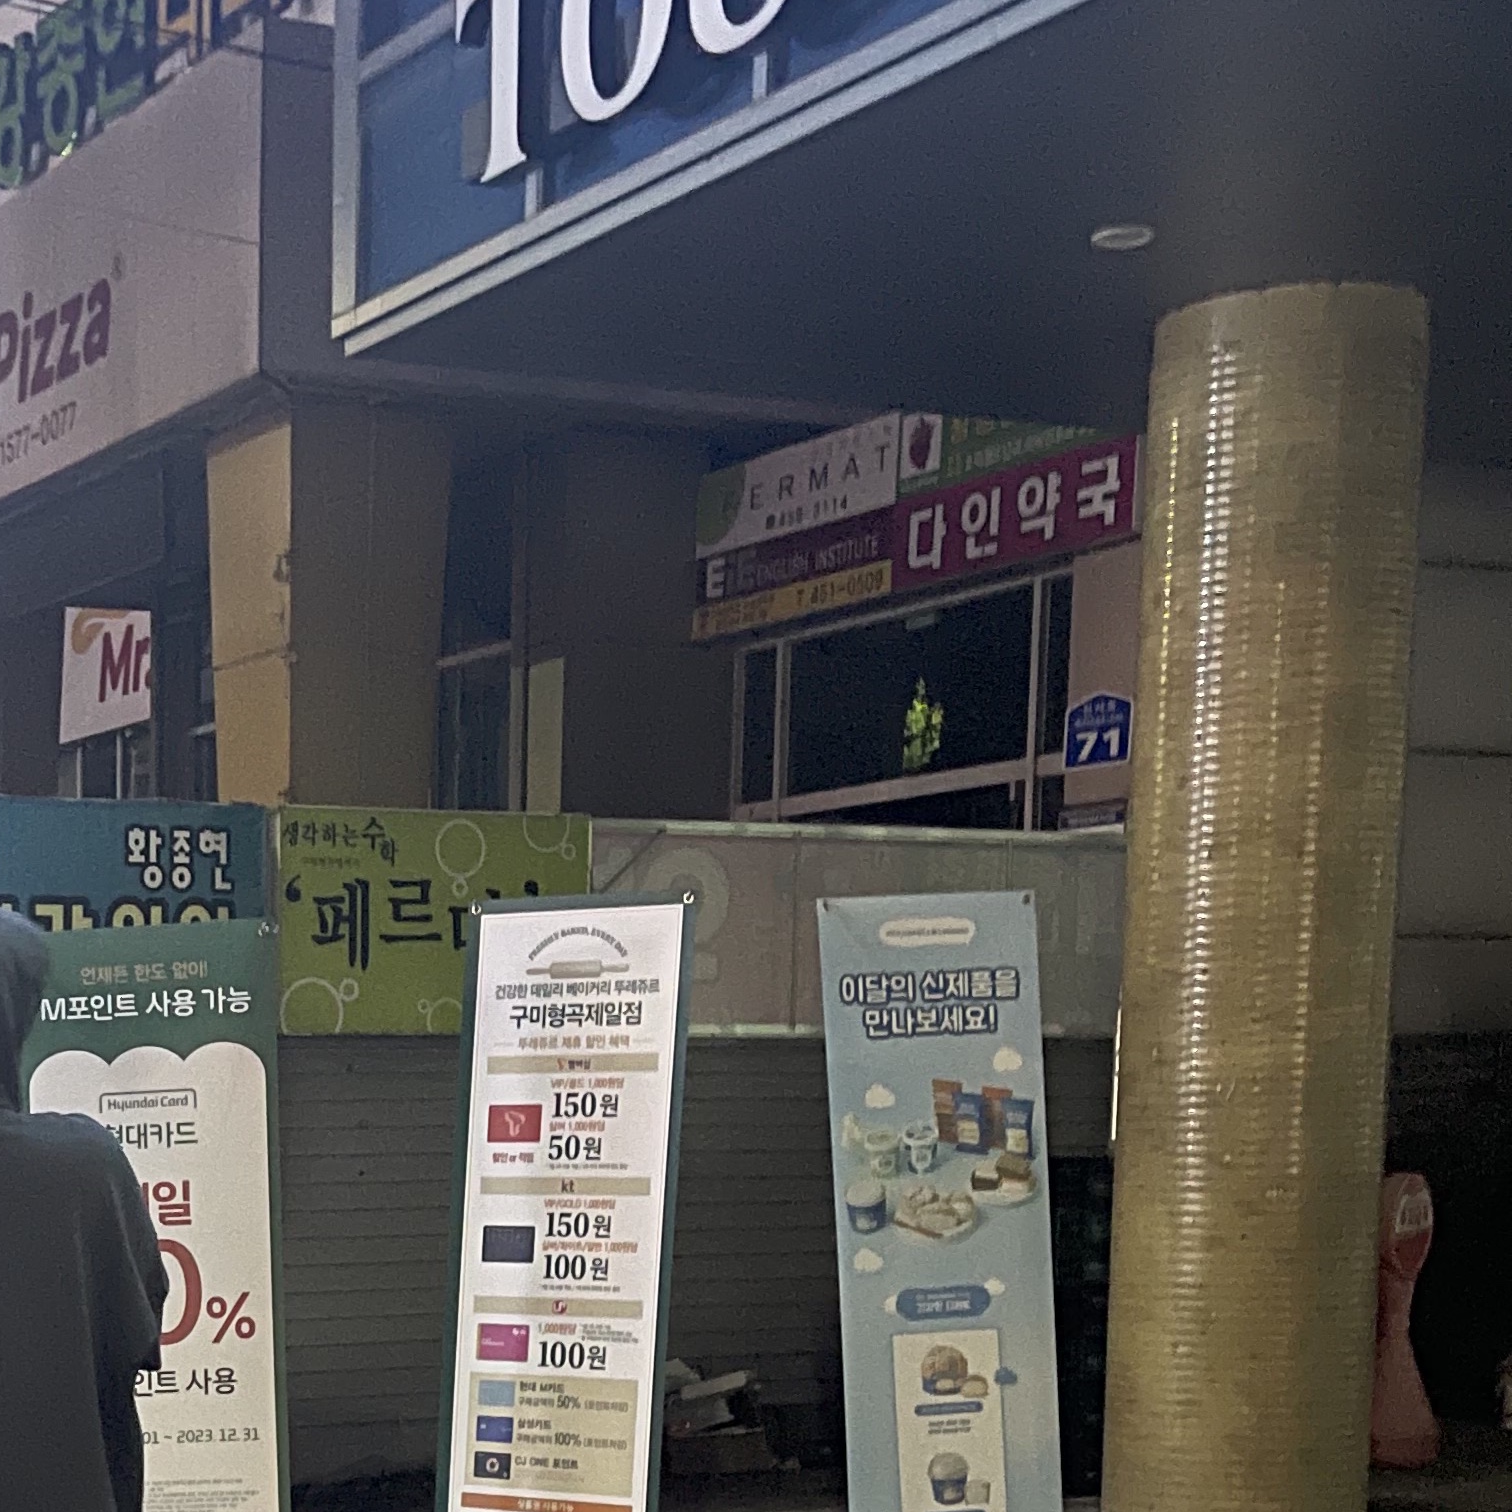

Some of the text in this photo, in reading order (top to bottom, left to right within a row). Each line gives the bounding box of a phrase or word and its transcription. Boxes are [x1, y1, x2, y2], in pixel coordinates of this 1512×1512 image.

[908, 452, 1121, 570] 다인약국
[1076, 728, 1120, 763] 71
[126, 826, 233, 891] 황종현
[40, 986, 252, 1022] M포인트 사용 가능
[840, 972, 915, 1004] 이달의
[509, 1000, 643, 1030] 구미형곡제일점
[863, 1004, 997, 1037] 만나보세요!
[107, 1093, 189, 1113] Hyundai Card
[143, 1179, 193, 1227] 일
[560, 1179, 575, 1194] kt
[186, 1366, 239, 1396] 사용
